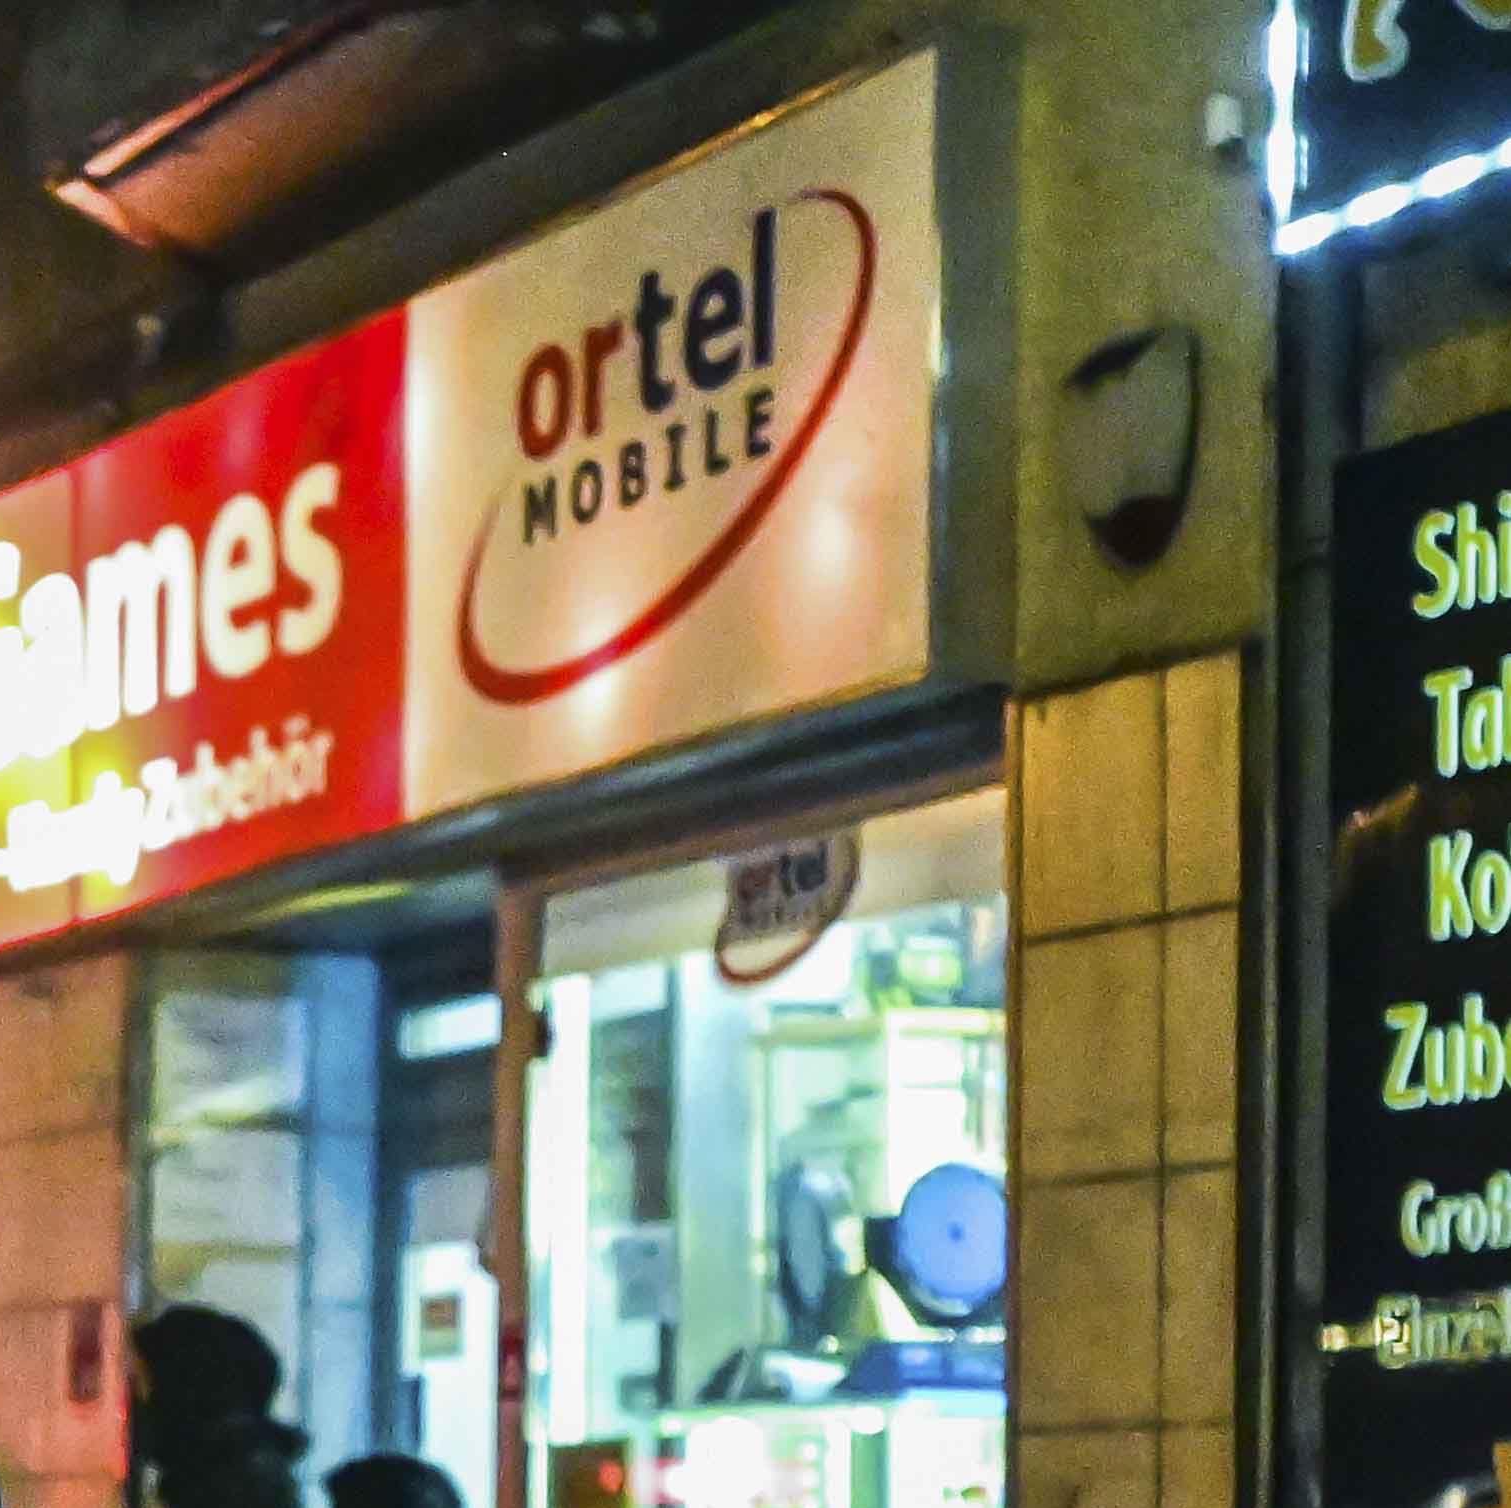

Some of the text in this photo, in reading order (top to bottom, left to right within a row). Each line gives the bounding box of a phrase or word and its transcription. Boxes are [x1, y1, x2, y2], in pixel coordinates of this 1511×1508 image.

[516, 205, 778, 461] ortel
[522, 387, 775, 547] MOBILE
[1423, 653, 1511, 778] Ta
[1382, 991, 1511, 1111] Zub
